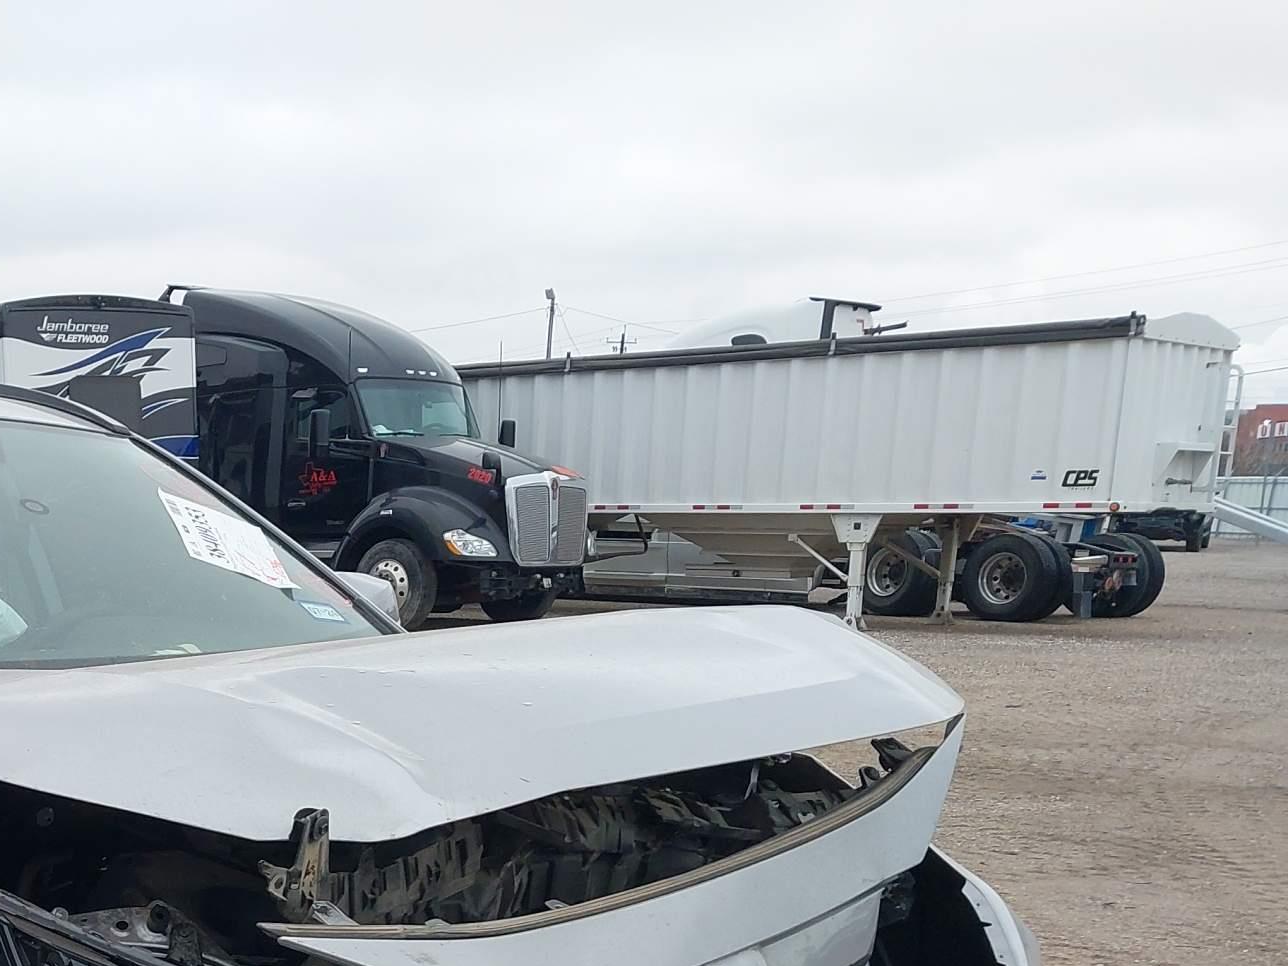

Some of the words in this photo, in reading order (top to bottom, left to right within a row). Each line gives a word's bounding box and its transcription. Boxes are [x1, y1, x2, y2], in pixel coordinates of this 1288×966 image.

[37, 315, 109, 333] Jamboree
[57, 334, 109, 344] FLEETWOOD
[311, 470, 337, 482] A&A
[1062, 469, 1100, 487] CPS
[184, 506, 230, 565] 38409353
